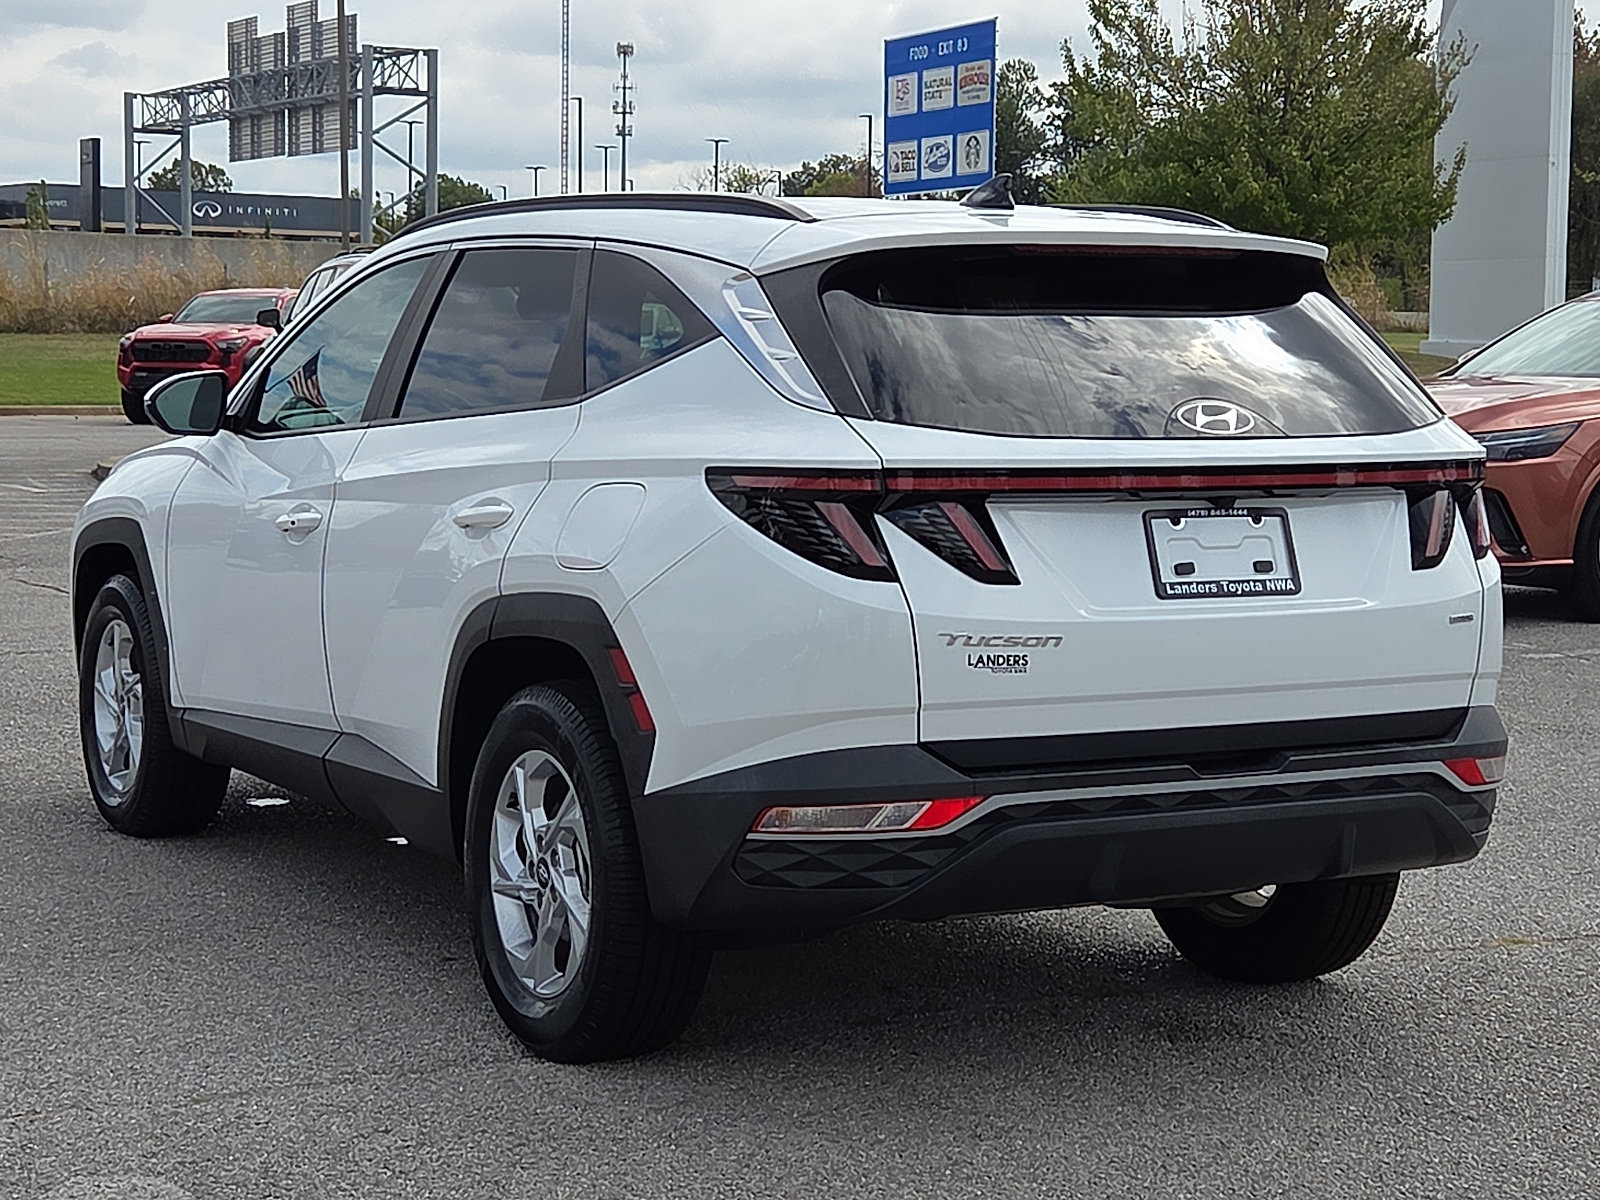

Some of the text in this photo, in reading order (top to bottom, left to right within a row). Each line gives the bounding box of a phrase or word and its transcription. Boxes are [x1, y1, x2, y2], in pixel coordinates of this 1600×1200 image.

[909, 45, 929, 60] FOOD
[938, 40, 954, 55] EXIT
[924, 76, 953, 90] NATURAL
[924, 90, 943, 101] STATE
[900, 149, 916, 160] TACO
[901, 160, 916, 172] BELL
[228, 205, 297, 218] INFINITI
[1166, 579, 1296, 595] Landers Toyota NWA
[967, 653, 1029, 668] LANDERS
